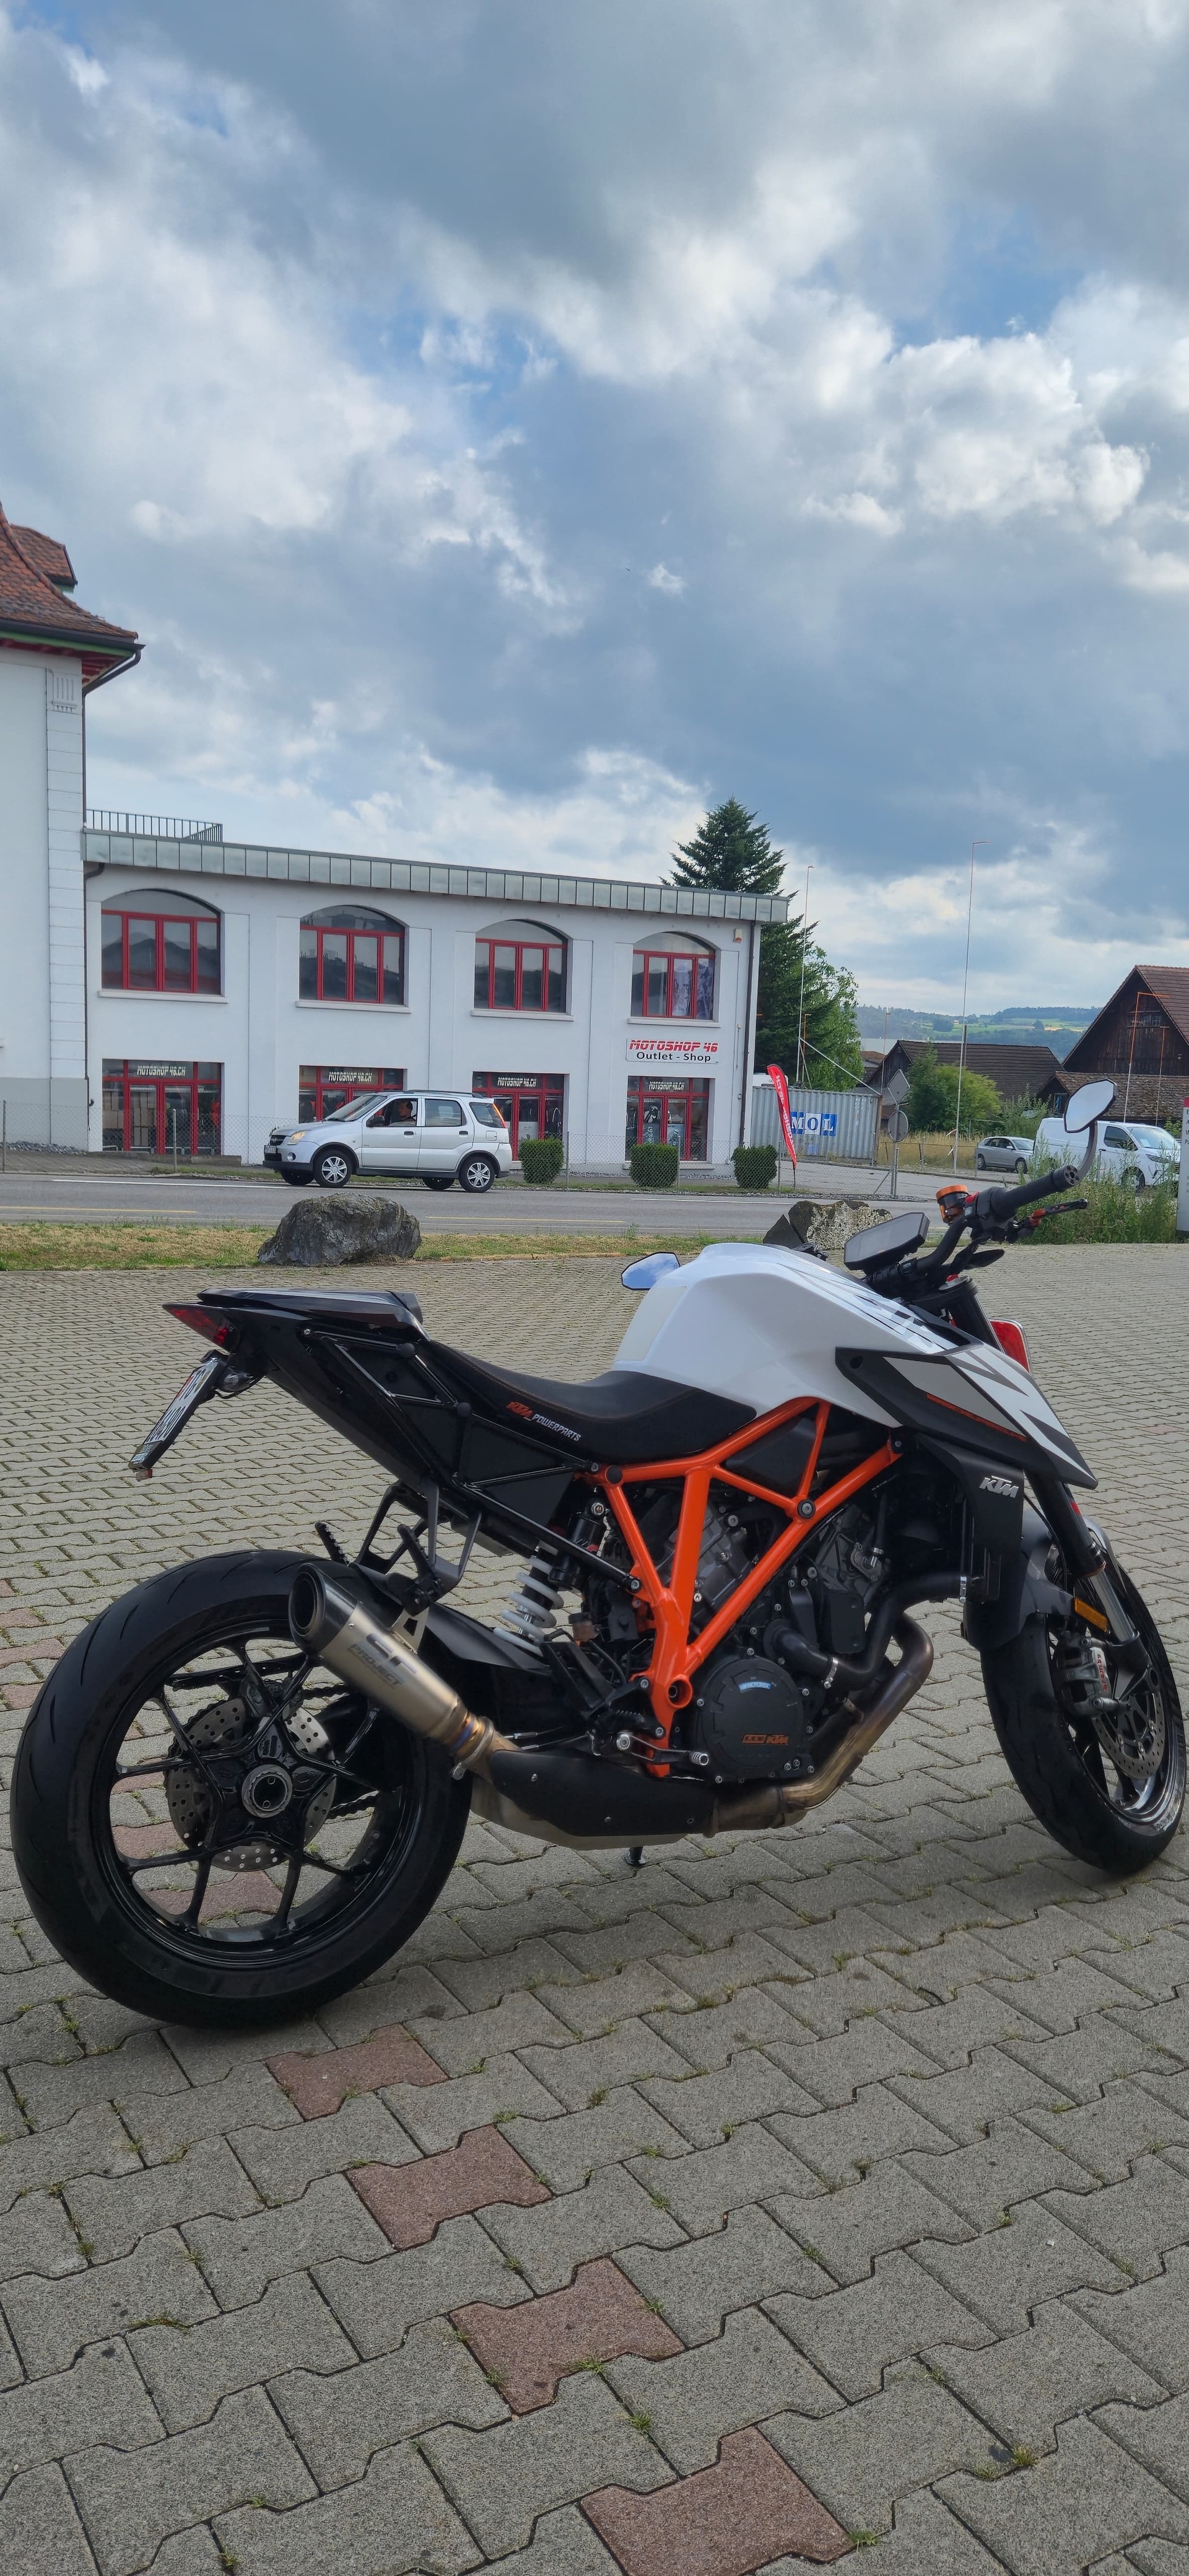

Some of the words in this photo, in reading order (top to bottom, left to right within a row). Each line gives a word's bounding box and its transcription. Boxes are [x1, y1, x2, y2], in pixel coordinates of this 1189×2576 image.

[629, 1040, 701, 1052] MOTOSHOP
[703, 1042, 718, 1053] 46
[637, 1051, 673, 1060] Outlet
[684, 1053, 711, 1062] Shop
[791, 1116, 834, 1131] MOL
[506, 1401, 533, 1418] KTM
[979, 1476, 1019, 1498] KTM
[350, 1643, 403, 1685] PROJECT
